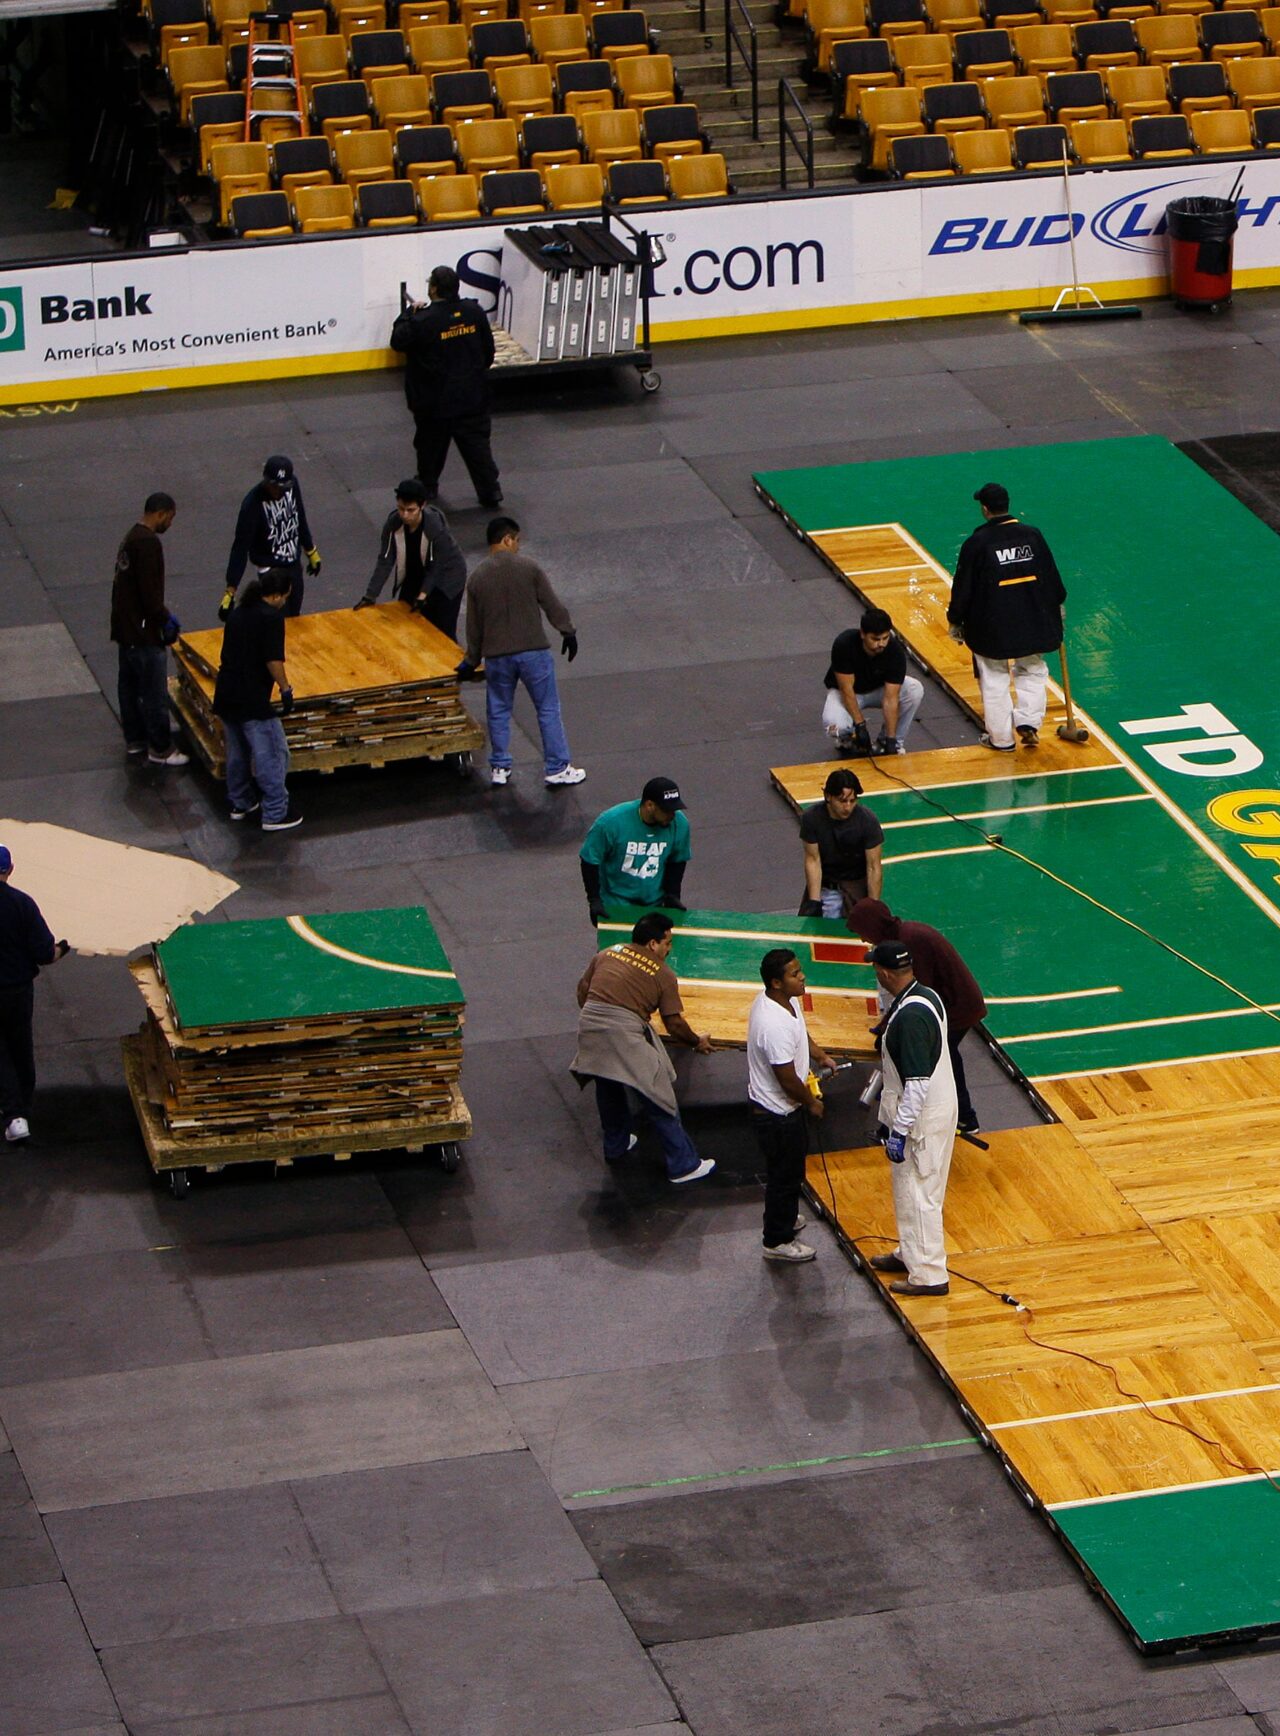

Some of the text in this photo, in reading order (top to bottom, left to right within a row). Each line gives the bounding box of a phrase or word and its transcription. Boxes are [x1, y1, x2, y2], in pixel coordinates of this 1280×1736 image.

[927, 213, 1086, 256] BUD
[40, 286, 153, 325] Bank
[44, 341, 127, 362] America's
[132, 336, 176, 353] Most
[181, 327, 280, 348] Convenient
[995, 545, 1034, 562] WM
[1118, 701, 1265, 778] TD
[621, 854, 660, 879] LA
[606, 951, 656, 976] EVENT STAFF
[622, 947, 661, 971] GARDEN
